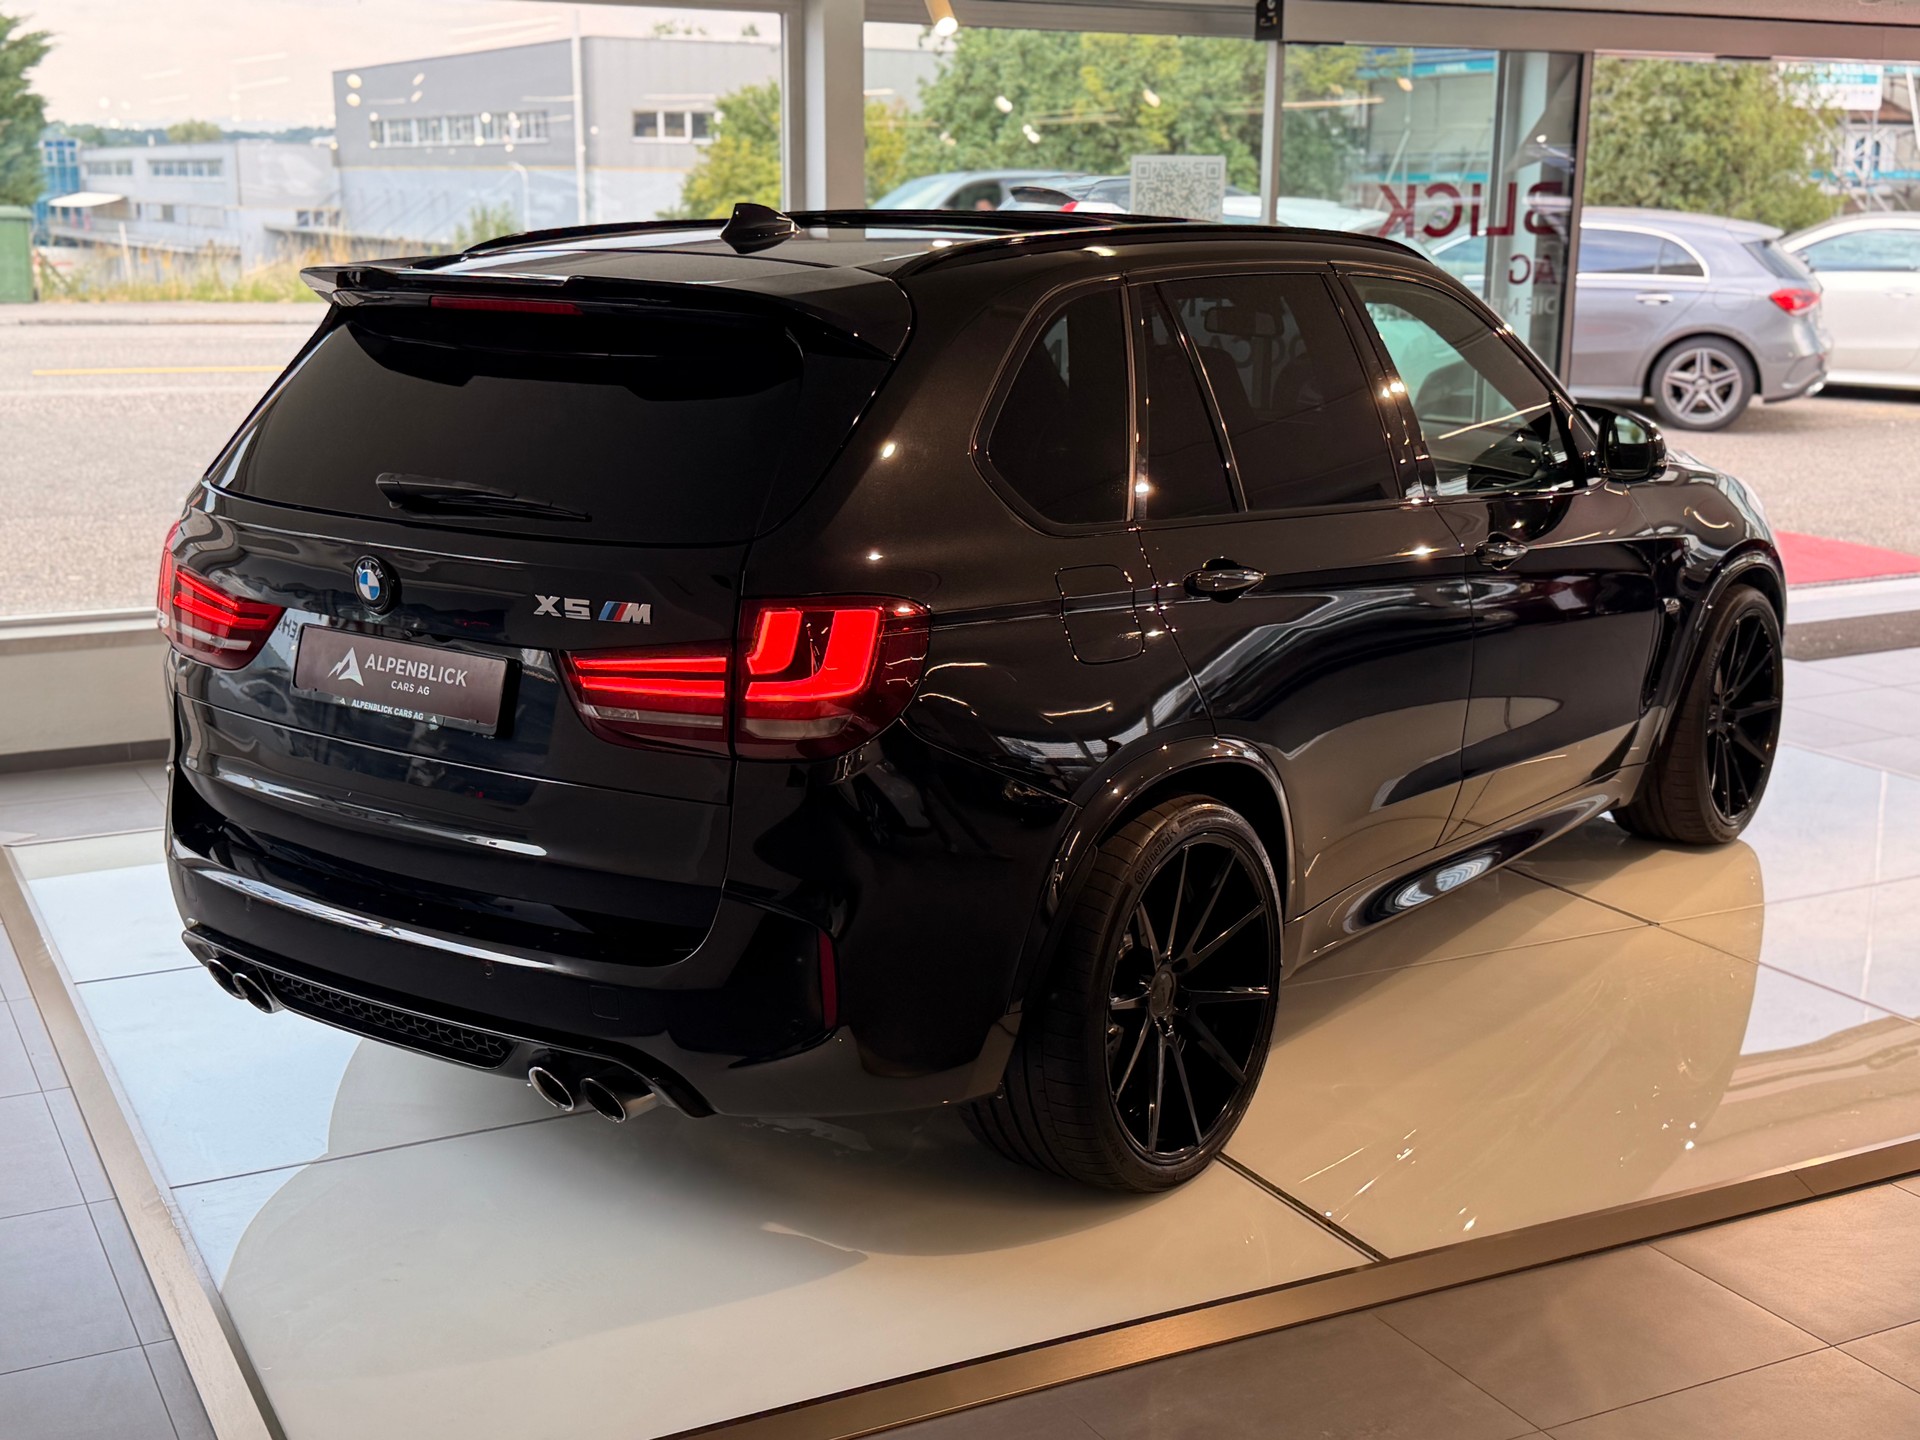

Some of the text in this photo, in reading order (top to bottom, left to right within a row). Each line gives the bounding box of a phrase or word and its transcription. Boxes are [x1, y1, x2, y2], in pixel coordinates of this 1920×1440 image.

[533, 594, 591, 620] X5
[364, 653, 468, 687] ALPENBLICK
[391, 680, 430, 696] CARS AG
[351, 699, 424, 721] ALPENBLICK CARS AG
